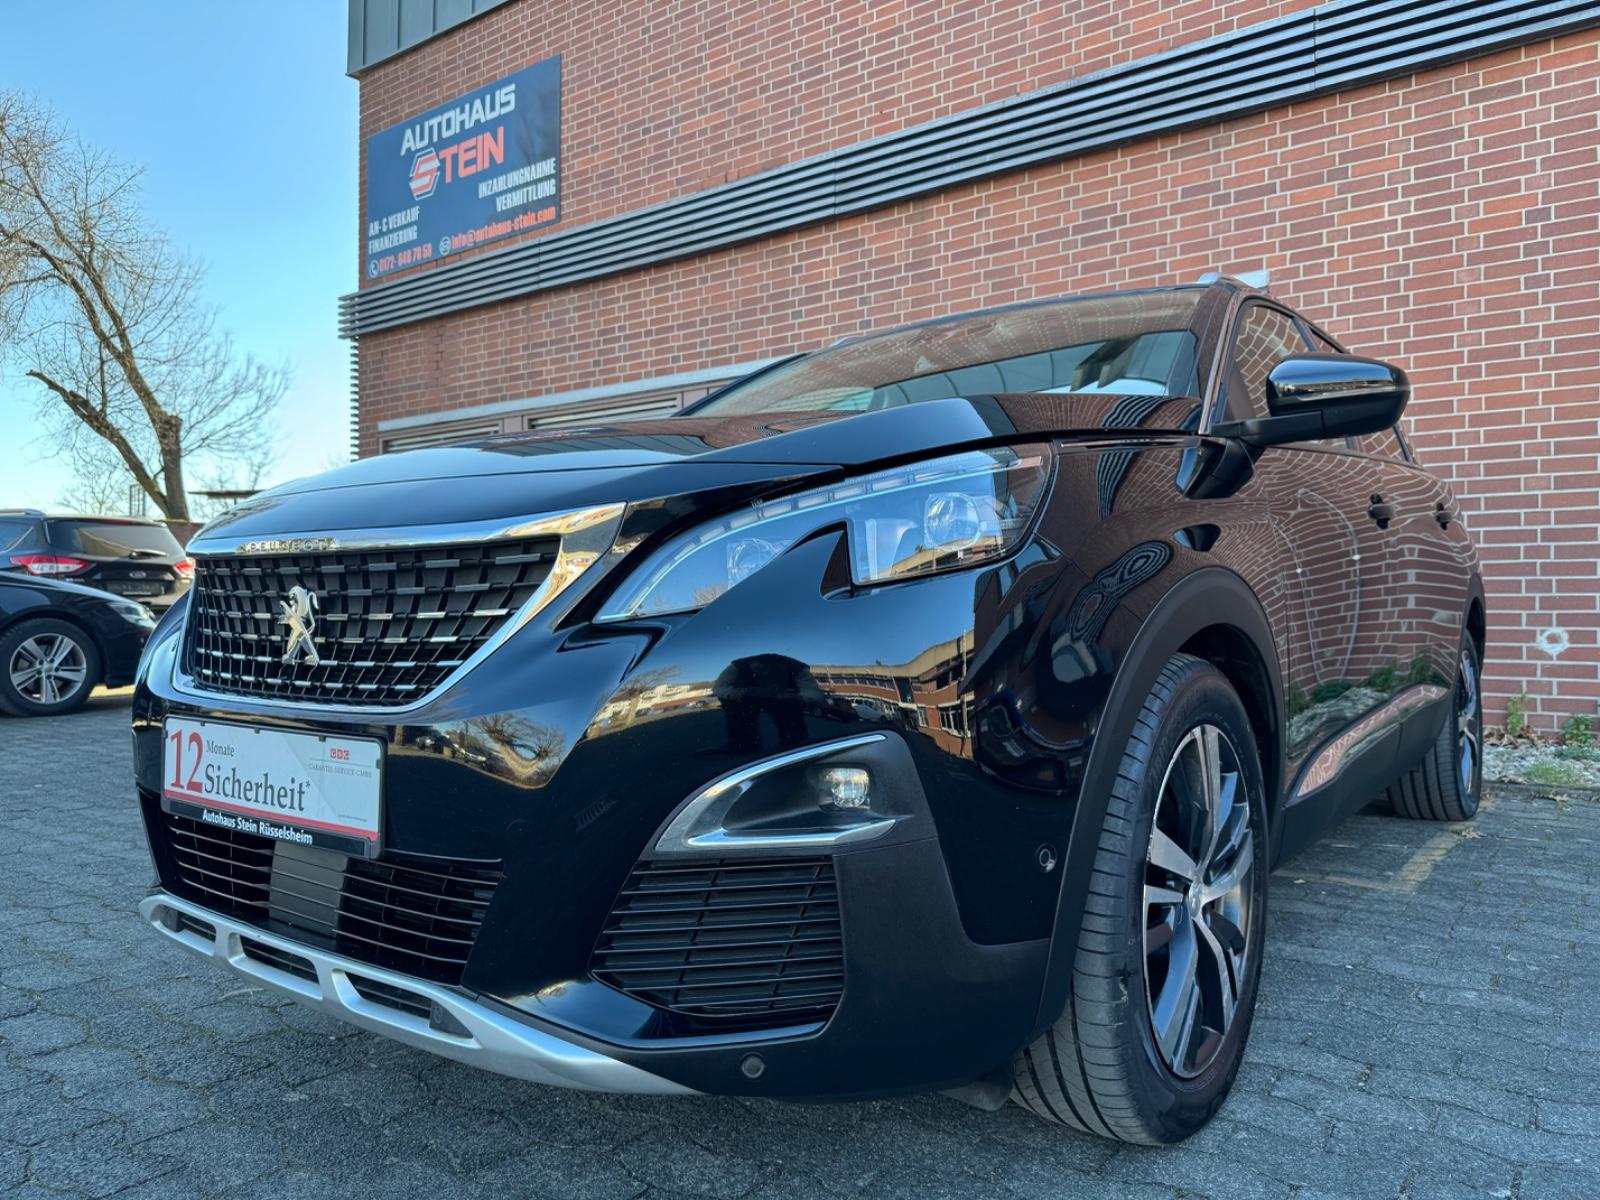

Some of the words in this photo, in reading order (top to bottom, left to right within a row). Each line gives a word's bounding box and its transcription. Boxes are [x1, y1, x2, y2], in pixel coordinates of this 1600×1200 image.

[401, 83, 516, 156] AUTOHAUS
[409, 126, 505, 201] STEIN
[495, 178, 556, 212] VERMITTLUNG
[388, 205, 420, 230] VERKAUF
[170, 729, 204, 793] 12
[206, 740, 235, 757] Monate
[203, 809, 236, 828] Autohaus
[237, 818, 258, 833] Stein
[259, 821, 313, 845] Rüsselsheim
